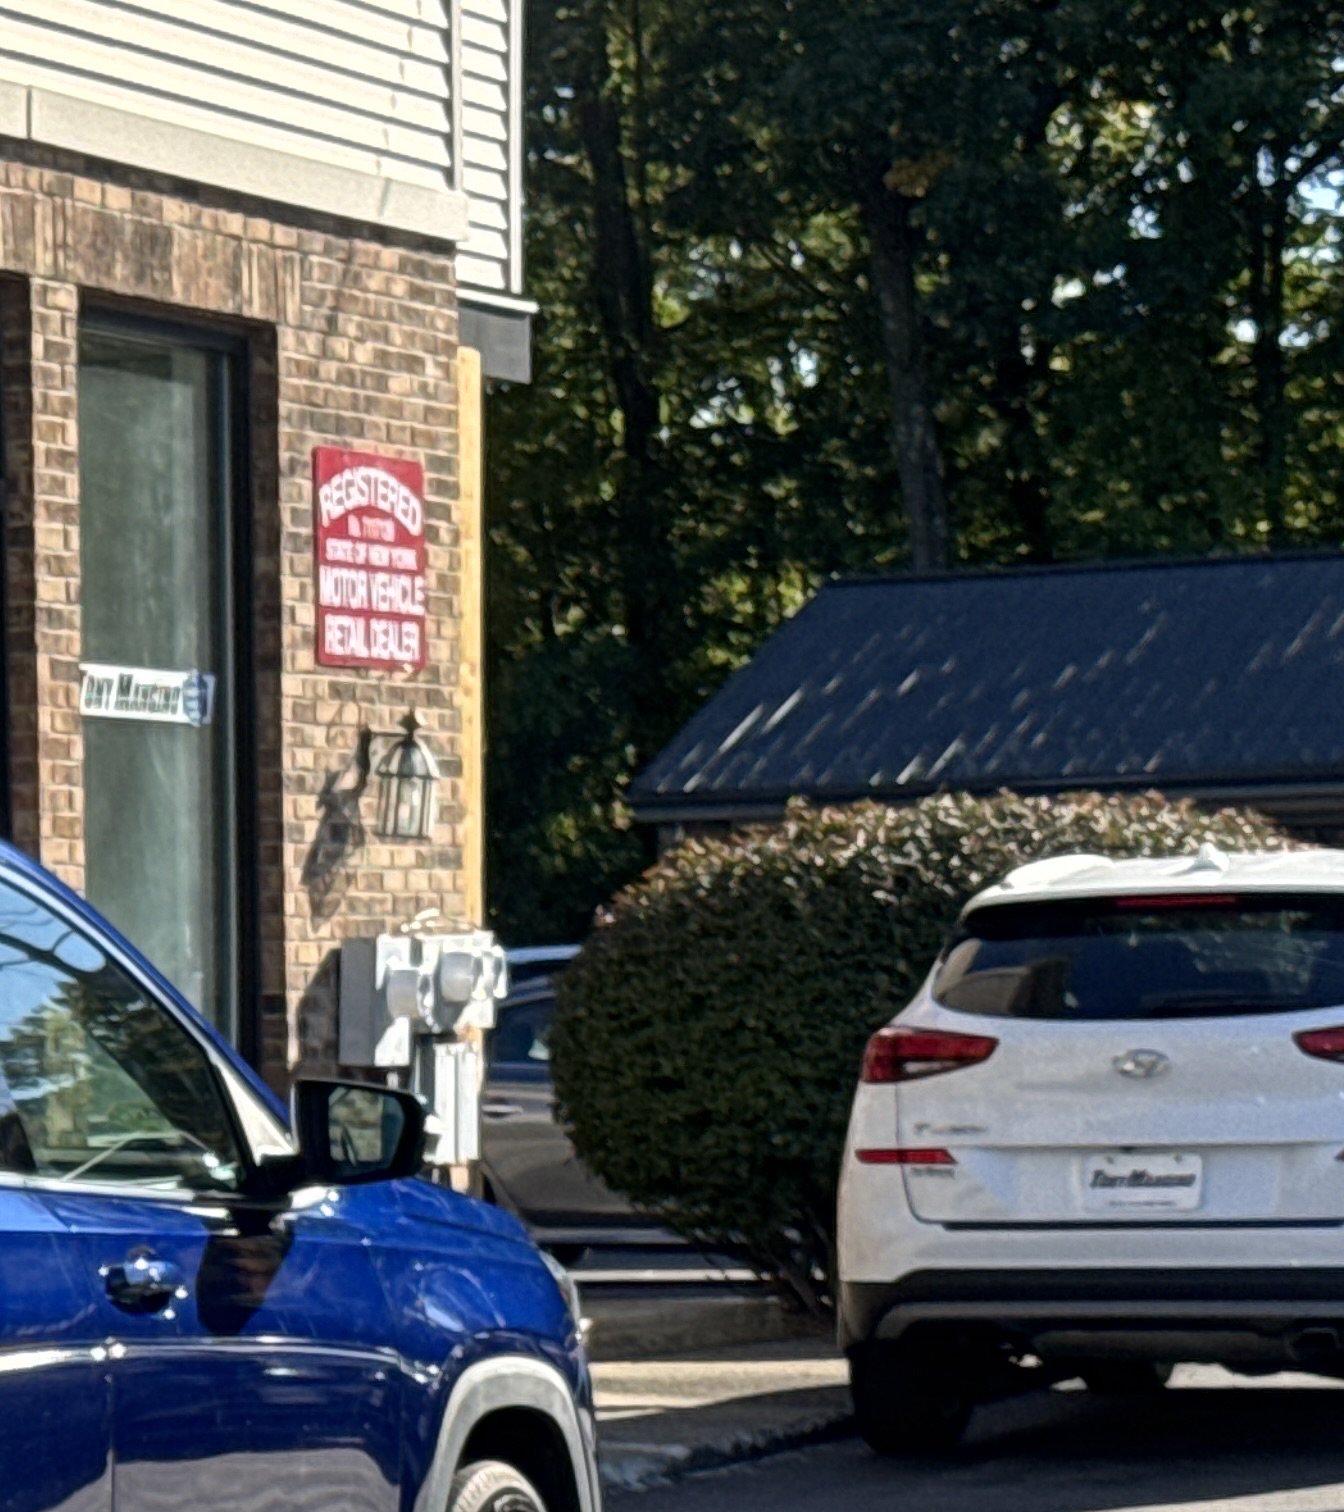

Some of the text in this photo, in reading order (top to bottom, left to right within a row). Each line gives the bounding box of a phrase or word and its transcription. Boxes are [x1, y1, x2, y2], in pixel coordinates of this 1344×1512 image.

[319, 466, 422, 537] REGISTERED
[319, 565, 426, 616] MOTOR VEHICLE
[324, 613, 420, 662] RETAIL DEALER
[80, 671, 114, 711] ONY
